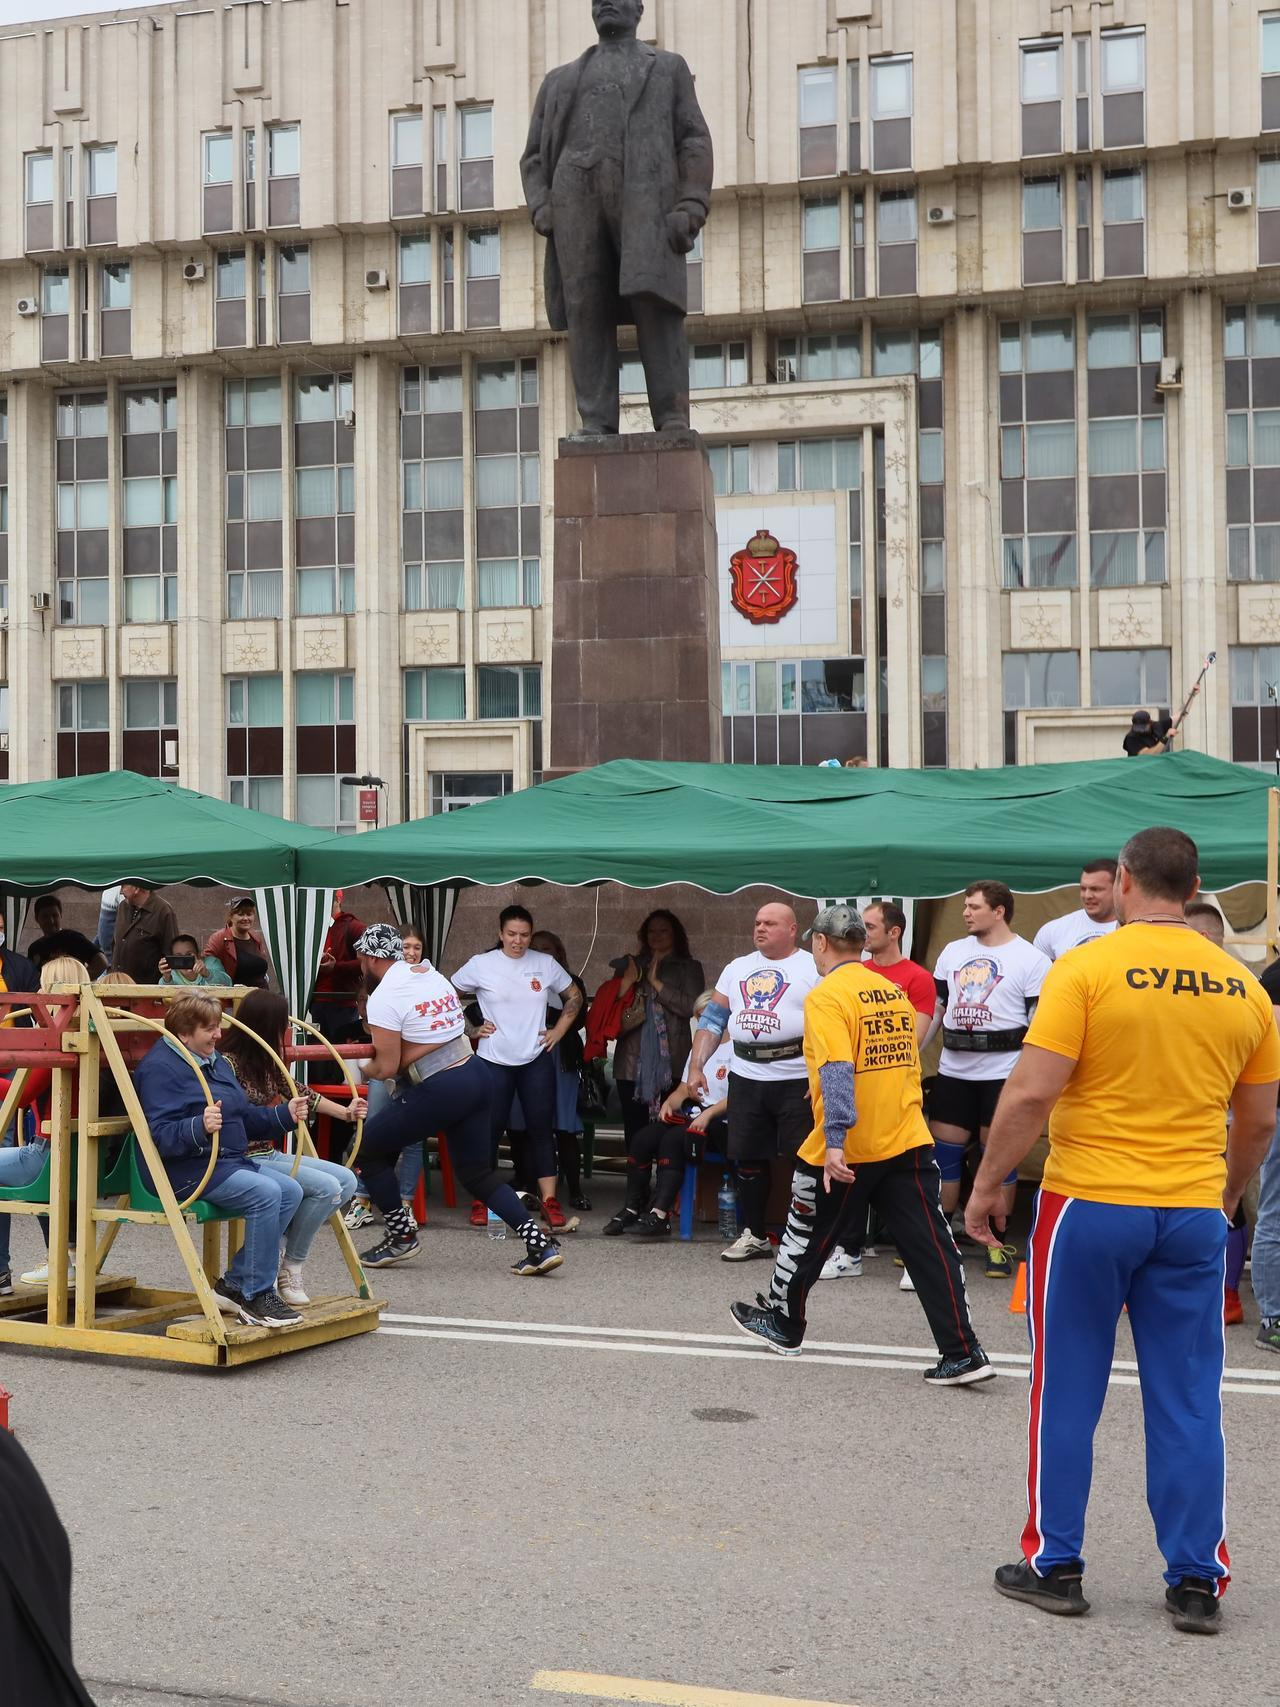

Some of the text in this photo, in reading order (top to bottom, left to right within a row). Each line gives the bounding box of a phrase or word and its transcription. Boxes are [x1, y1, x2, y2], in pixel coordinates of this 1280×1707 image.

[1126, 967, 1246, 999] СУДЬЯ
[858, 989, 906, 1005] СУДЬЯ
[953, 1007, 991, 1020] НАЦИЯ
[737, 1013, 780, 1029] НАЦИЯ
[742, 1022, 770, 1033] МИРА
[957, 1018, 982, 1026] МИРА
